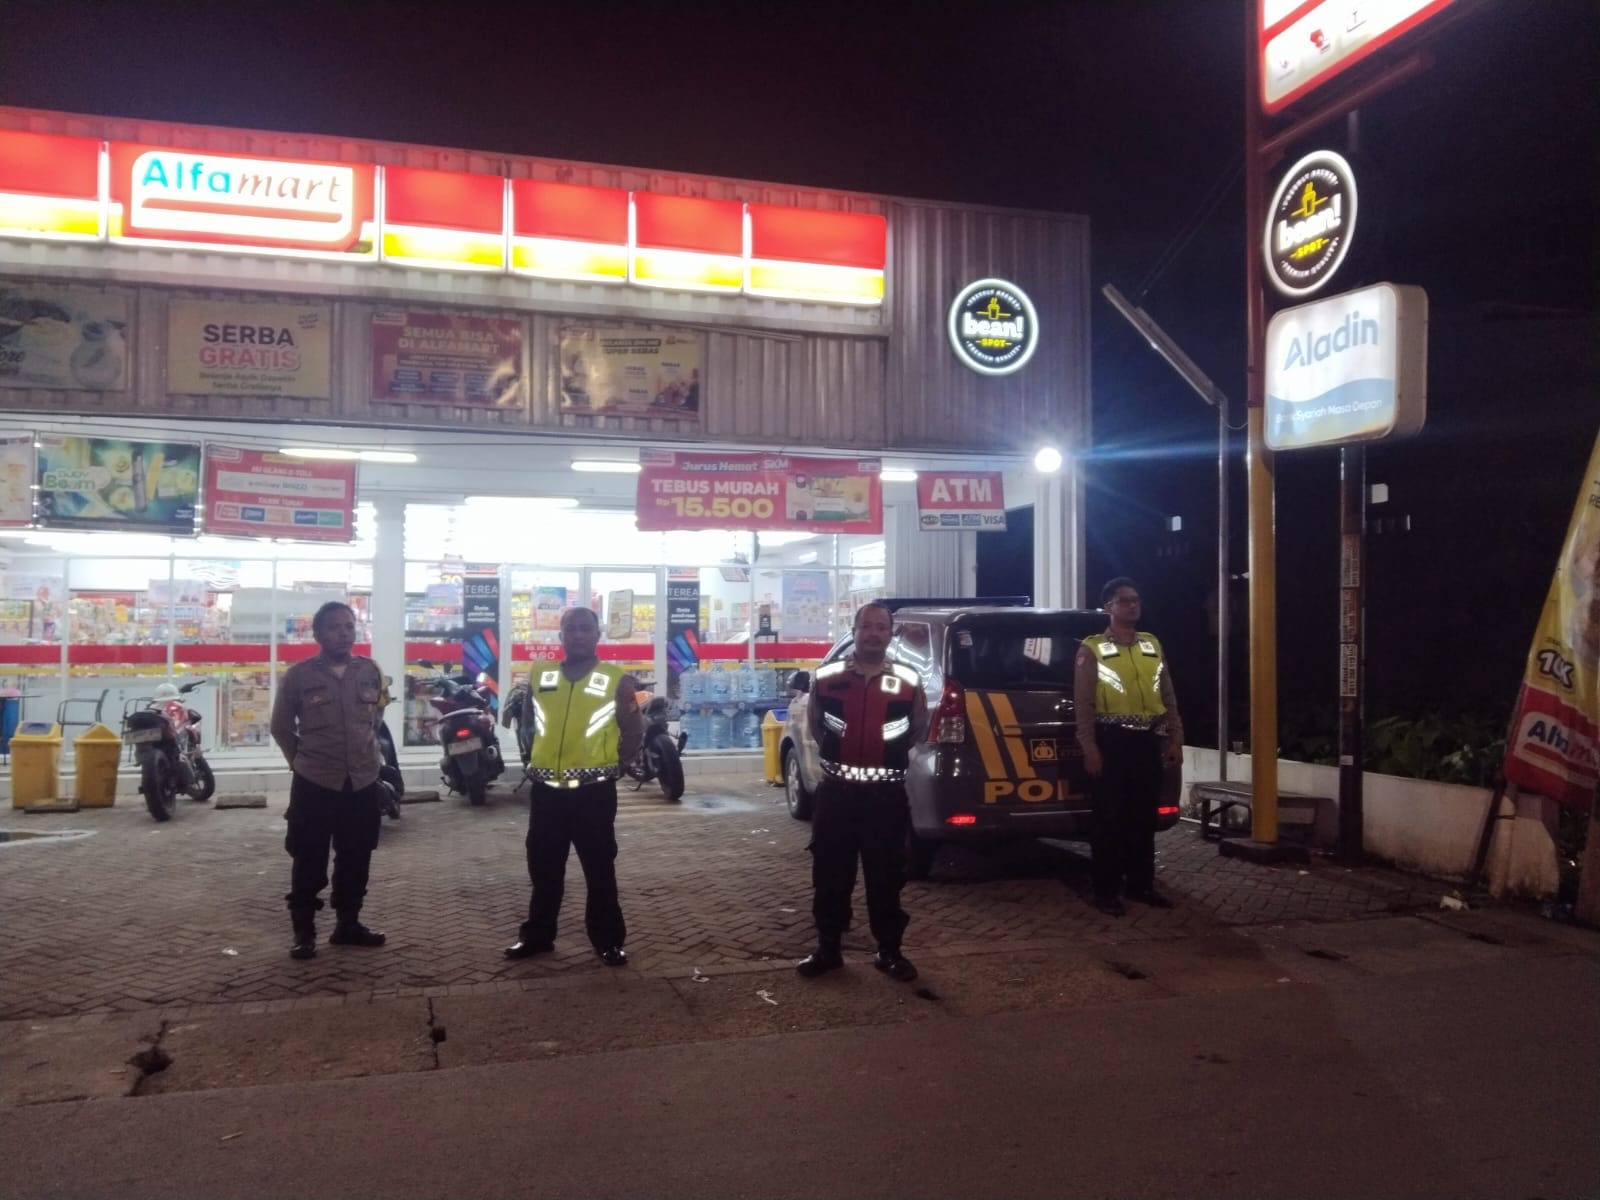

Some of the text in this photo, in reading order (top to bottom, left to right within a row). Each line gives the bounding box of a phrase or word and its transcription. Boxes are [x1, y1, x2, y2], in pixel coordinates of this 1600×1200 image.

[142, 157, 344, 203] Alfamart
[1296, 238, 1323, 259] SPOT
[203, 323, 295, 346] SERBA
[963, 311, 1024, 338] bean!
[981, 338, 1006, 347] SPOT
[1283, 310, 1379, 371] Aladin
[199, 346, 298, 369] GRATIS
[719, 462, 758, 472] Hemat
[651, 479, 779, 495] TEBUS MURAH
[930, 478, 993, 502] ATM
[671, 496, 774, 519] 15.500
[982, 514, 1004, 525] VISA
[465, 584, 498, 594] TEREA
[668, 587, 698, 597] TEREA
